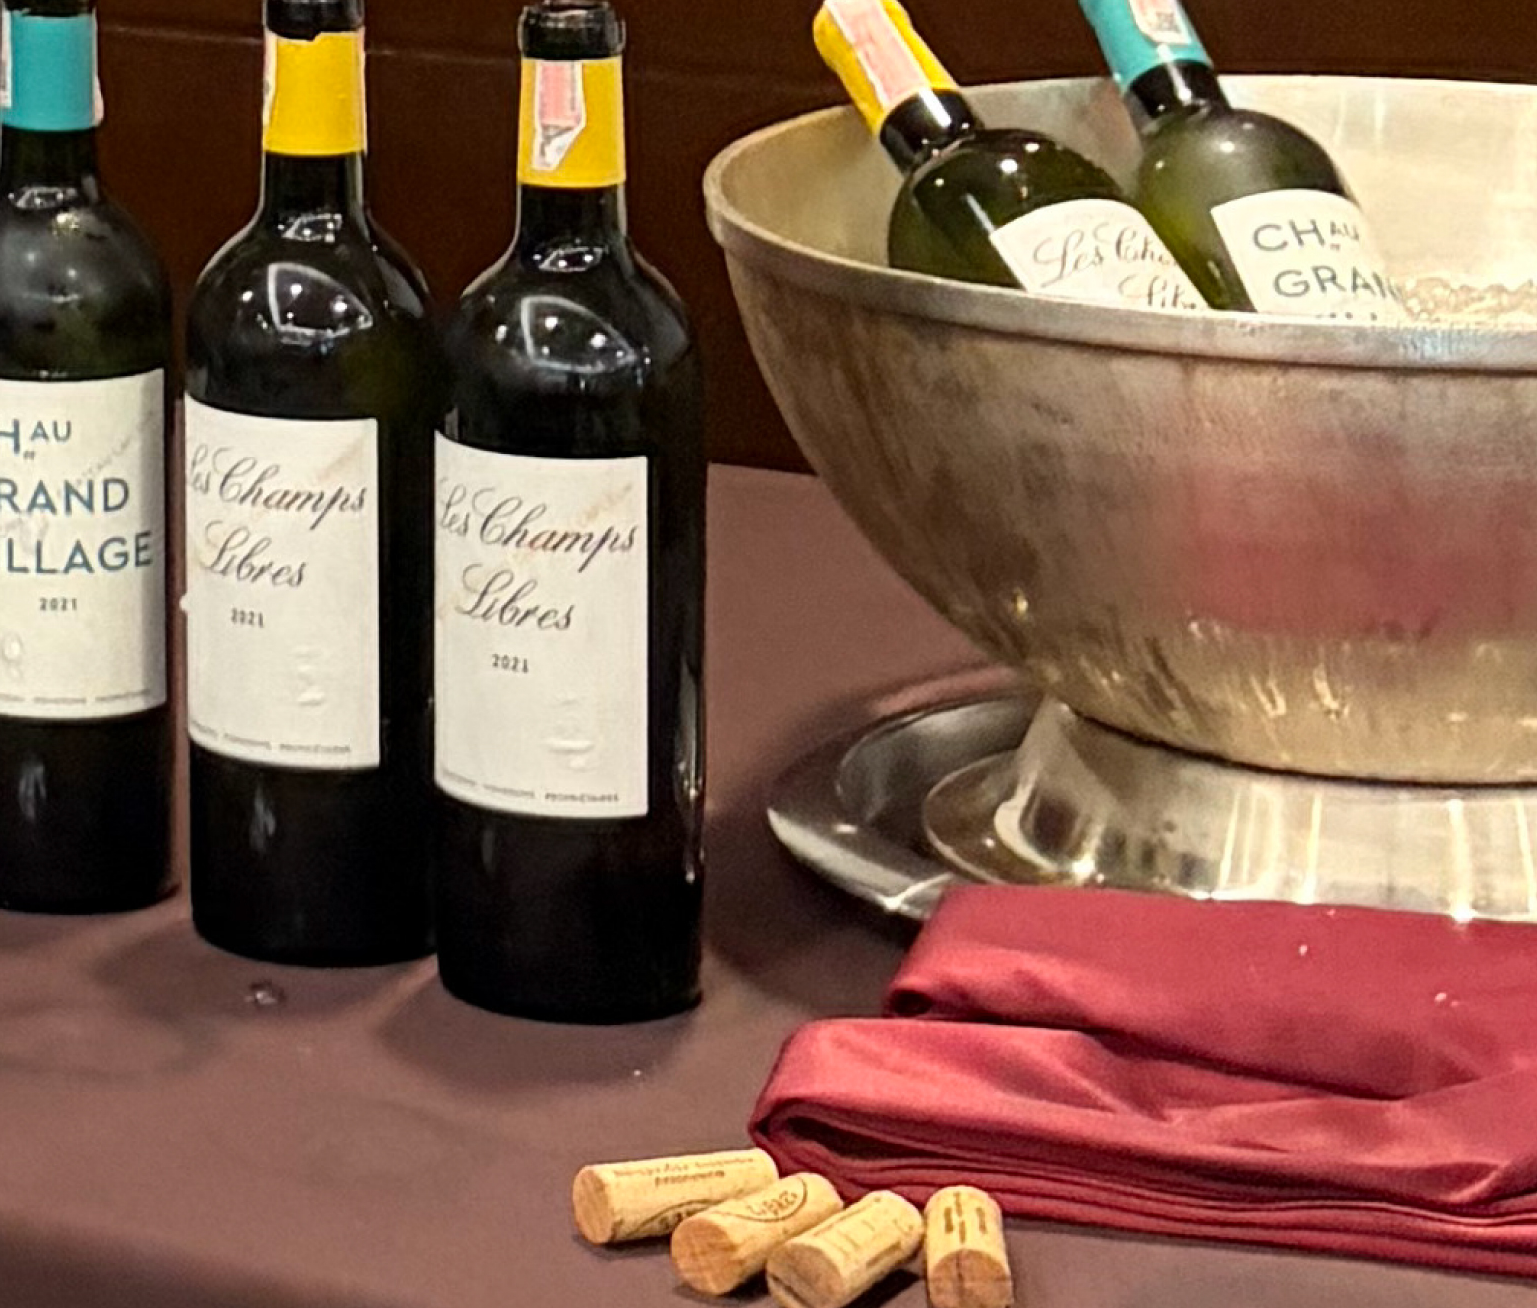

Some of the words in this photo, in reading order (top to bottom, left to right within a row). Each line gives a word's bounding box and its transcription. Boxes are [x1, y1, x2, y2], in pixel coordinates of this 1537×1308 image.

[212, 446, 369, 531] Champs
[201, 519, 308, 588] Libres
[472, 486, 640, 574] Champs
[39, 597, 78, 612] 2021
[454, 562, 575, 631] Libres
[491, 653, 529, 674] 2021
